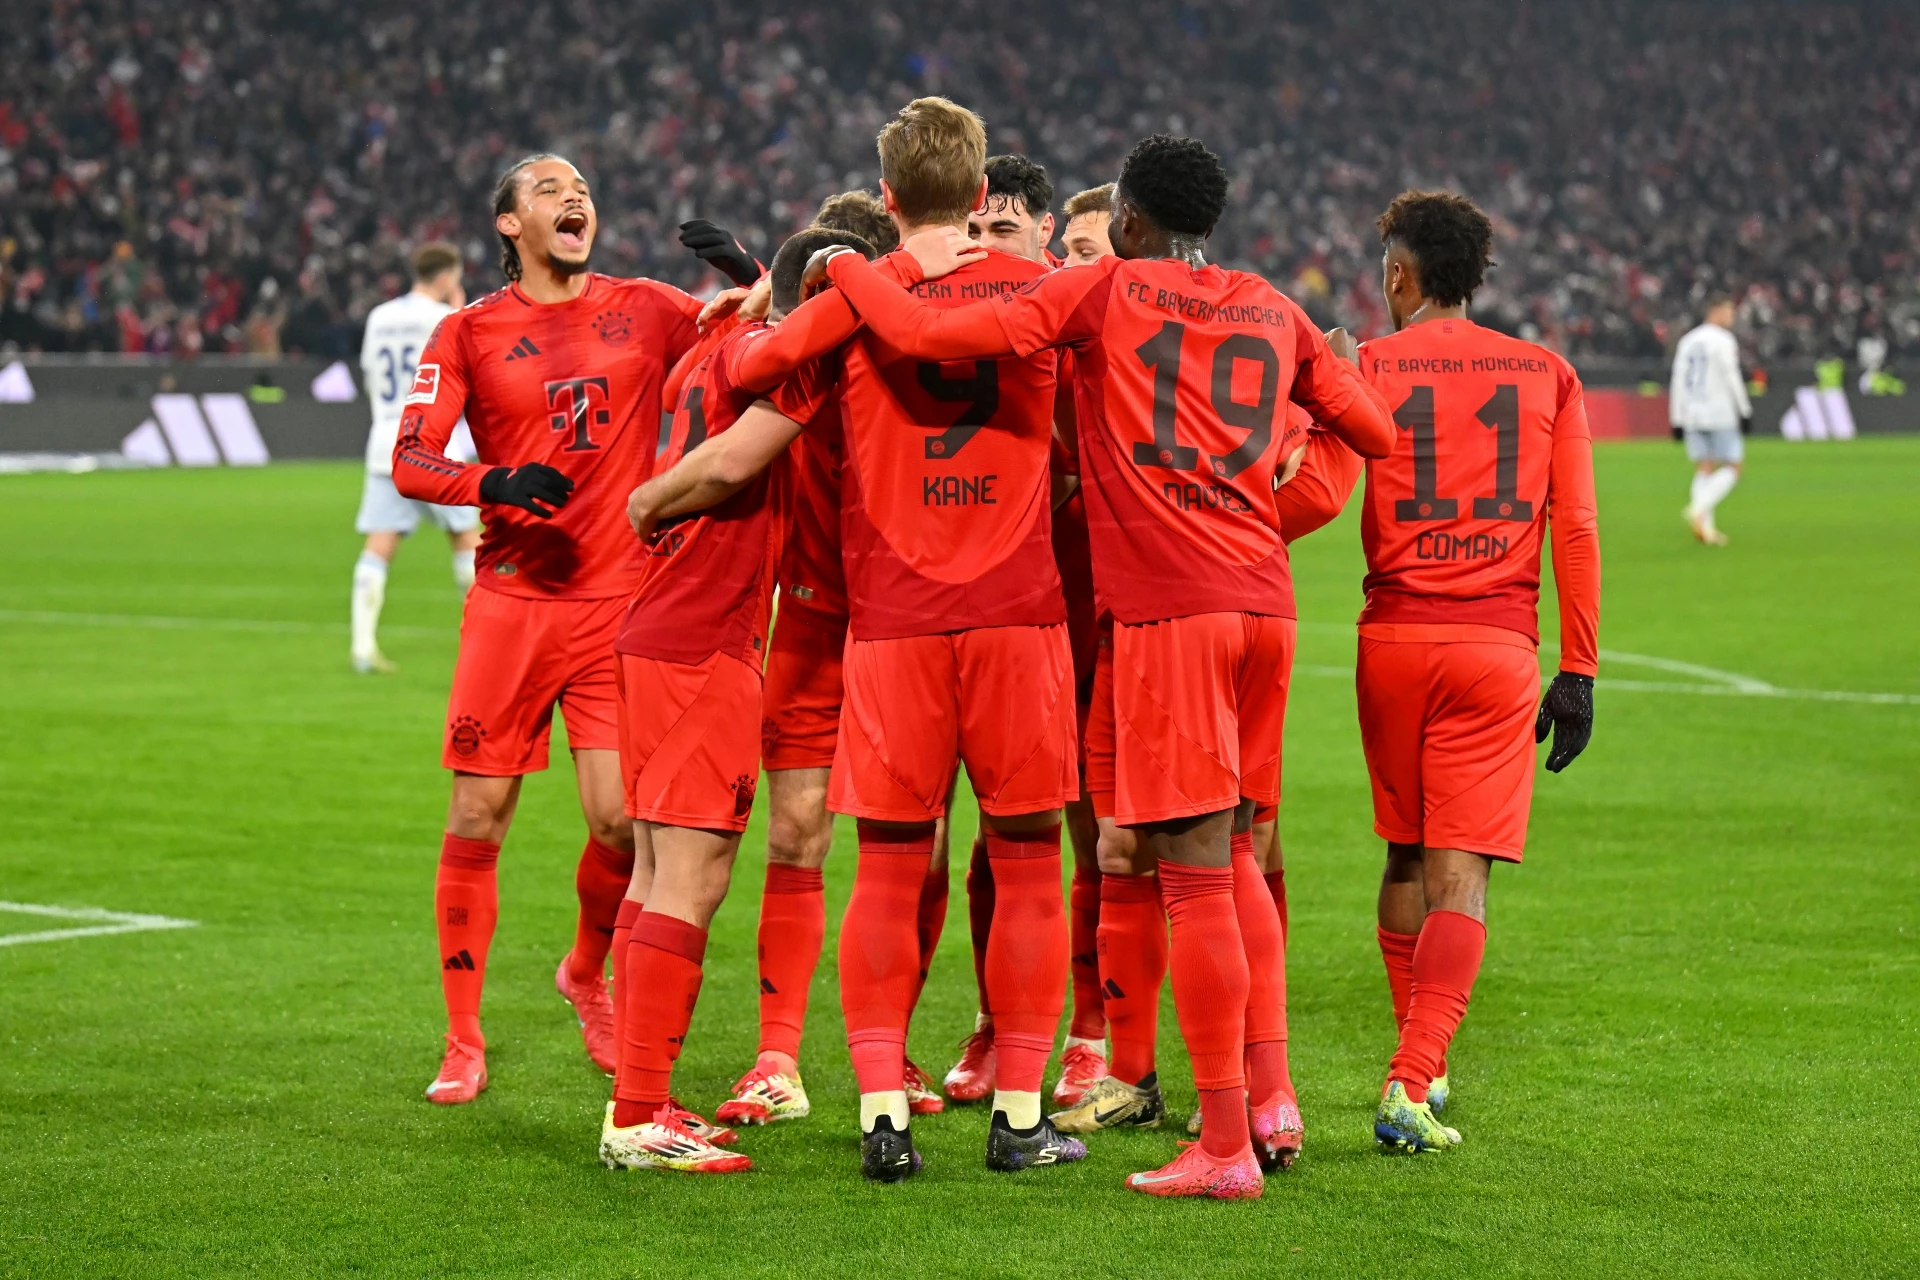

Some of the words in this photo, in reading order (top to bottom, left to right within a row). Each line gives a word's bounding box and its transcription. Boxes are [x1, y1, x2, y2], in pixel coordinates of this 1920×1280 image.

[909, 281, 952, 299] ERN
[961, 281, 1029, 299] MÜNCH
[1127, 281, 1151, 303] FC
[1156, 288, 1218, 322] BAYERN
[1217, 304, 1286, 328] MÜNCHEN
[1373, 358, 1391, 374] FC
[1398, 358, 1464, 374] BAYERN
[1472, 357, 1548, 374] MÜNCHEN
[917, 359, 999, 460] 9
[1134, 319, 1280, 481] 19
[1392, 384, 1534, 523] 11
[923, 475, 998, 506] KANE
[1416, 532, 1508, 561] COMAN
